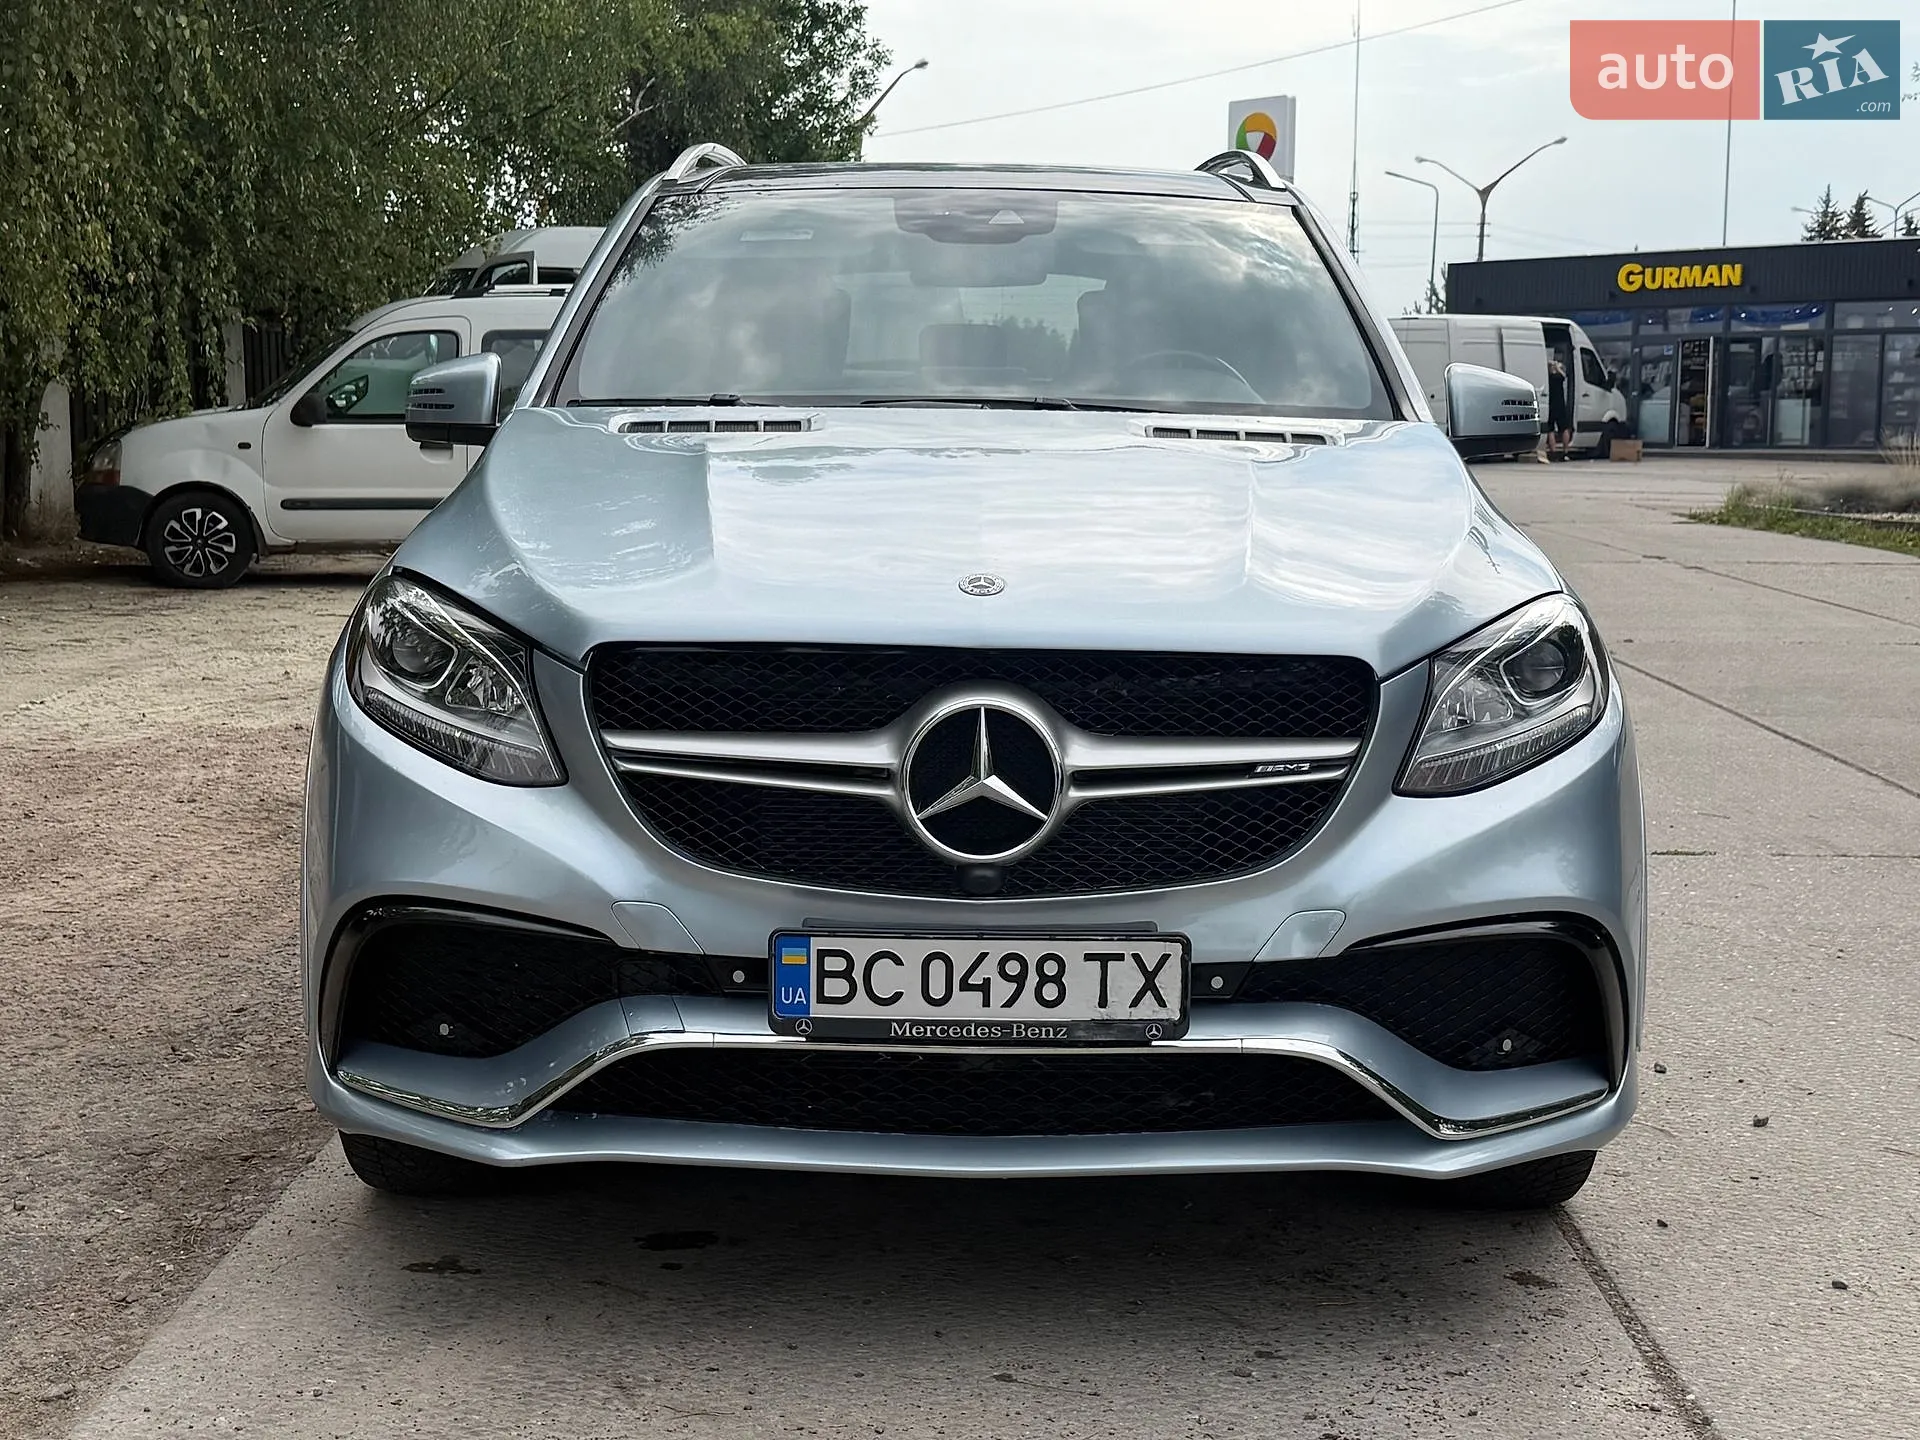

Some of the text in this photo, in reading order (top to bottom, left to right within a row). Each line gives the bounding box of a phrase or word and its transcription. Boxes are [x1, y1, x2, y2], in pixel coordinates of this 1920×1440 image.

[1617, 262, 1743, 293] GURMAN
[816, 948, 1172, 1009] BC 0498 TX
[781, 986, 807, 1005] UA
[889, 1021, 1069, 1040] Mercedes-Benz
